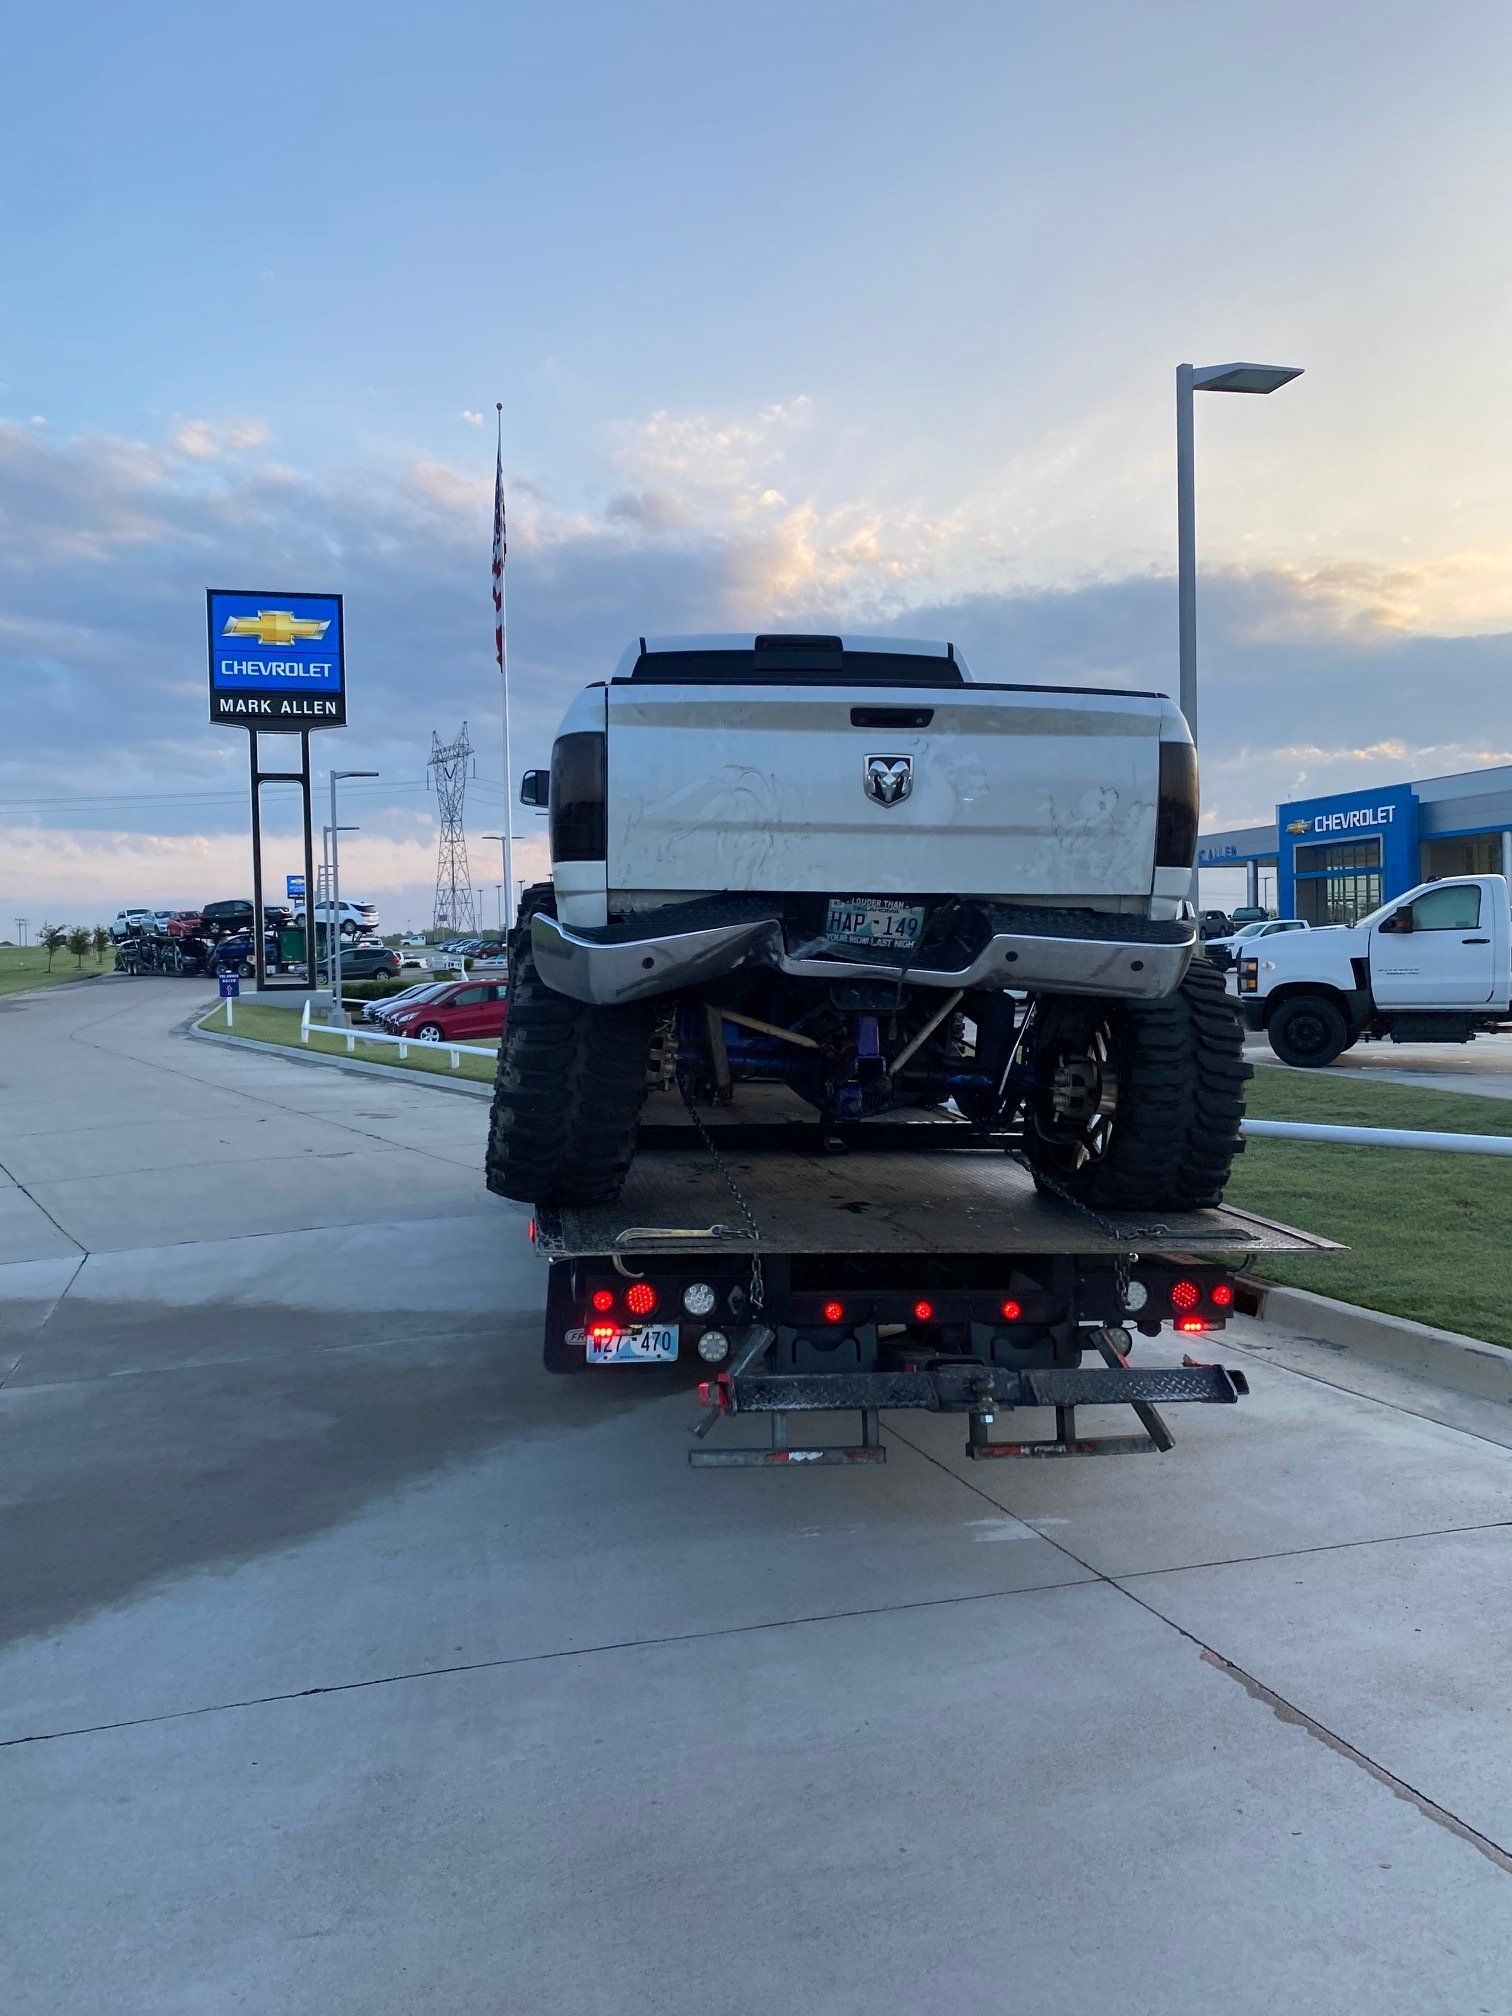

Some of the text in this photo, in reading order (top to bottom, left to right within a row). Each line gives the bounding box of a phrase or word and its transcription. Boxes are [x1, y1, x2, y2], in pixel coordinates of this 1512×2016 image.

[221, 660, 332, 678] CHEVROLET
[219, 698, 336, 715] MARK ALLEN
[1314, 805, 1396, 833] CHEVROLET
[1208, 844, 1238, 859] ALLEN
[851, 897, 906, 909] LOUDER THAN
[870, 936, 892, 947] LAST
